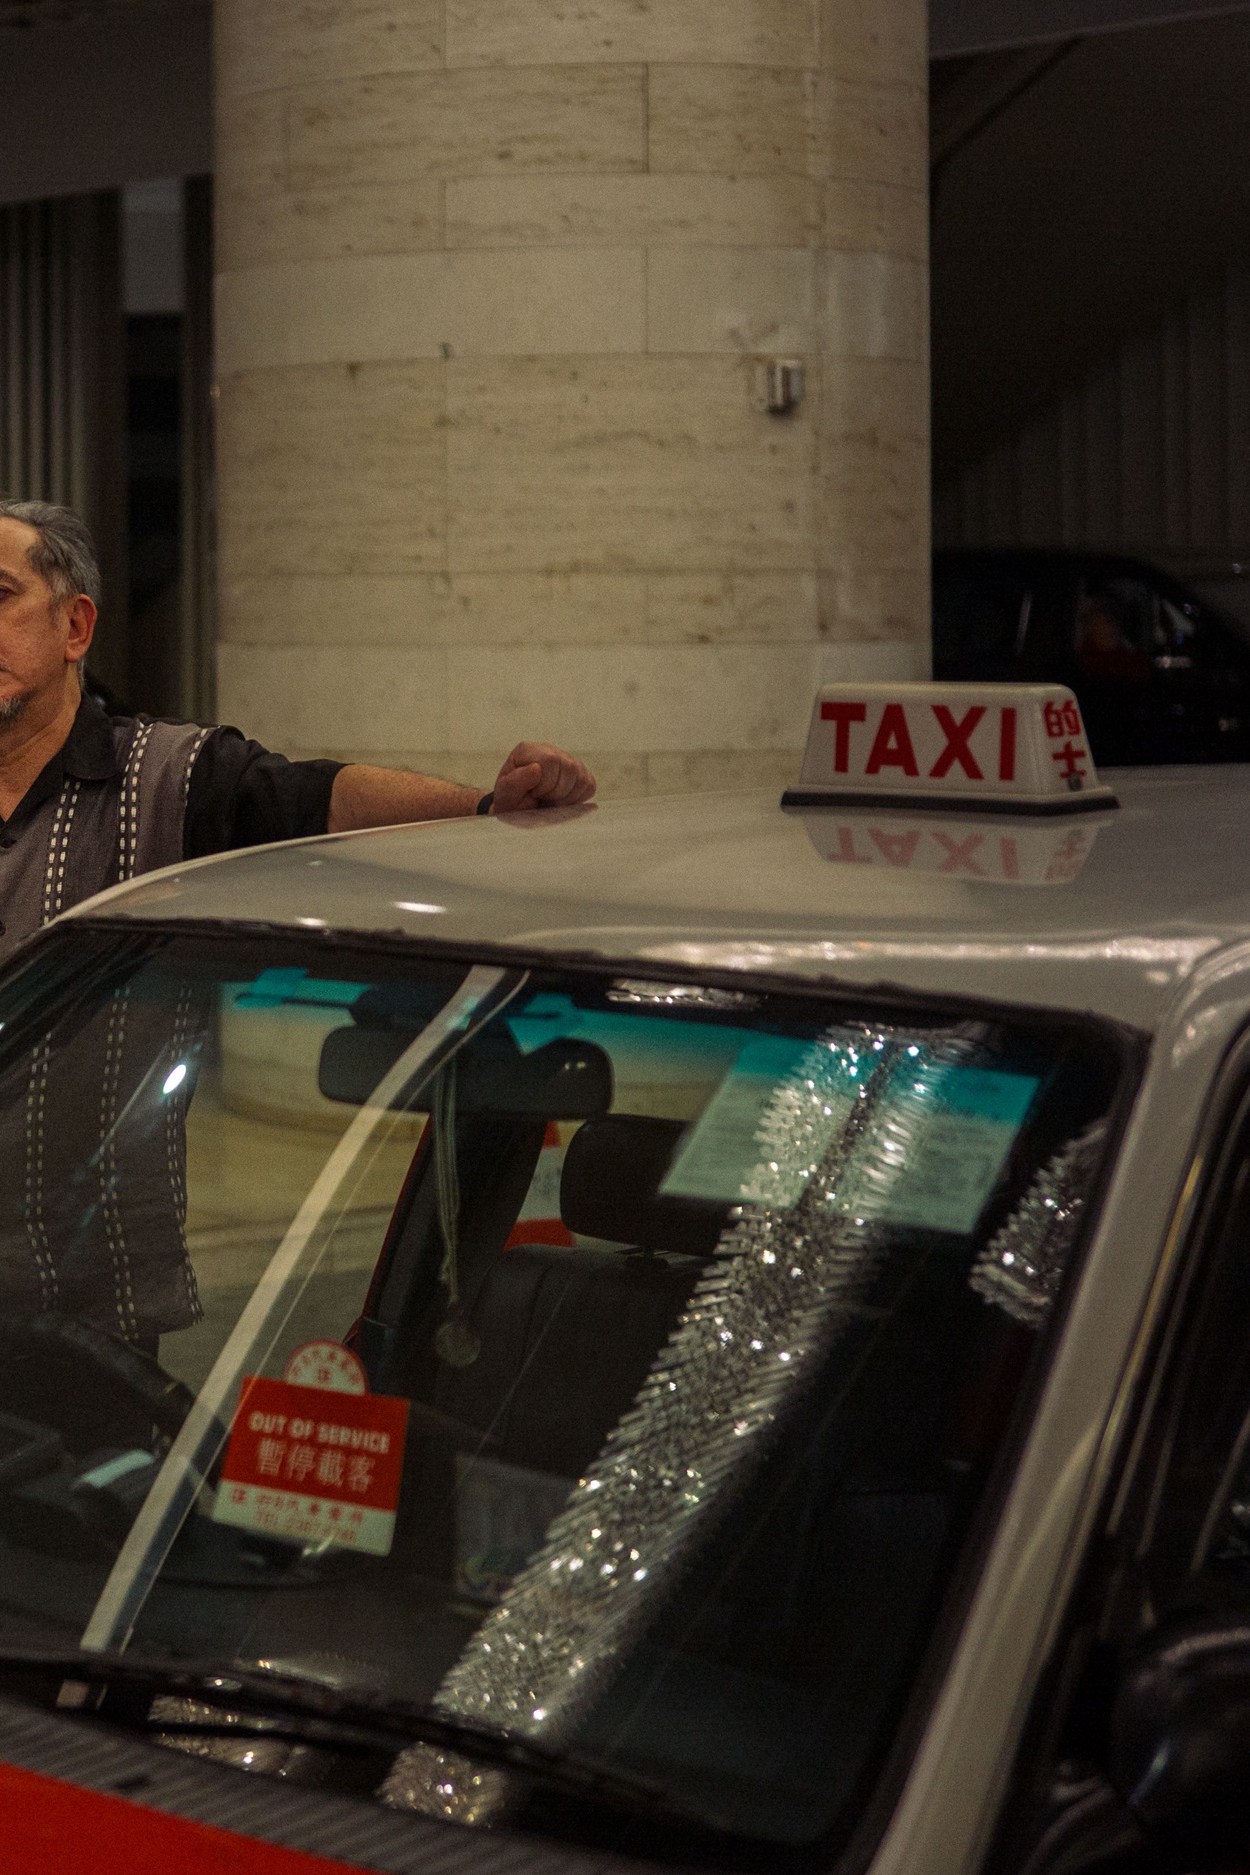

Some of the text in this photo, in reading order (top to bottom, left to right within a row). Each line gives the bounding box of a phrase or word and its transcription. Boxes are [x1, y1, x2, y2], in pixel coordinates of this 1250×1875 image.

[821, 702, 1017, 781] TAXI
[1043, 699, 1087, 780] 的士
[248, 1411, 391, 1454] OUT OF SERVICE
[256, 1437, 376, 1494] 暫停載客
